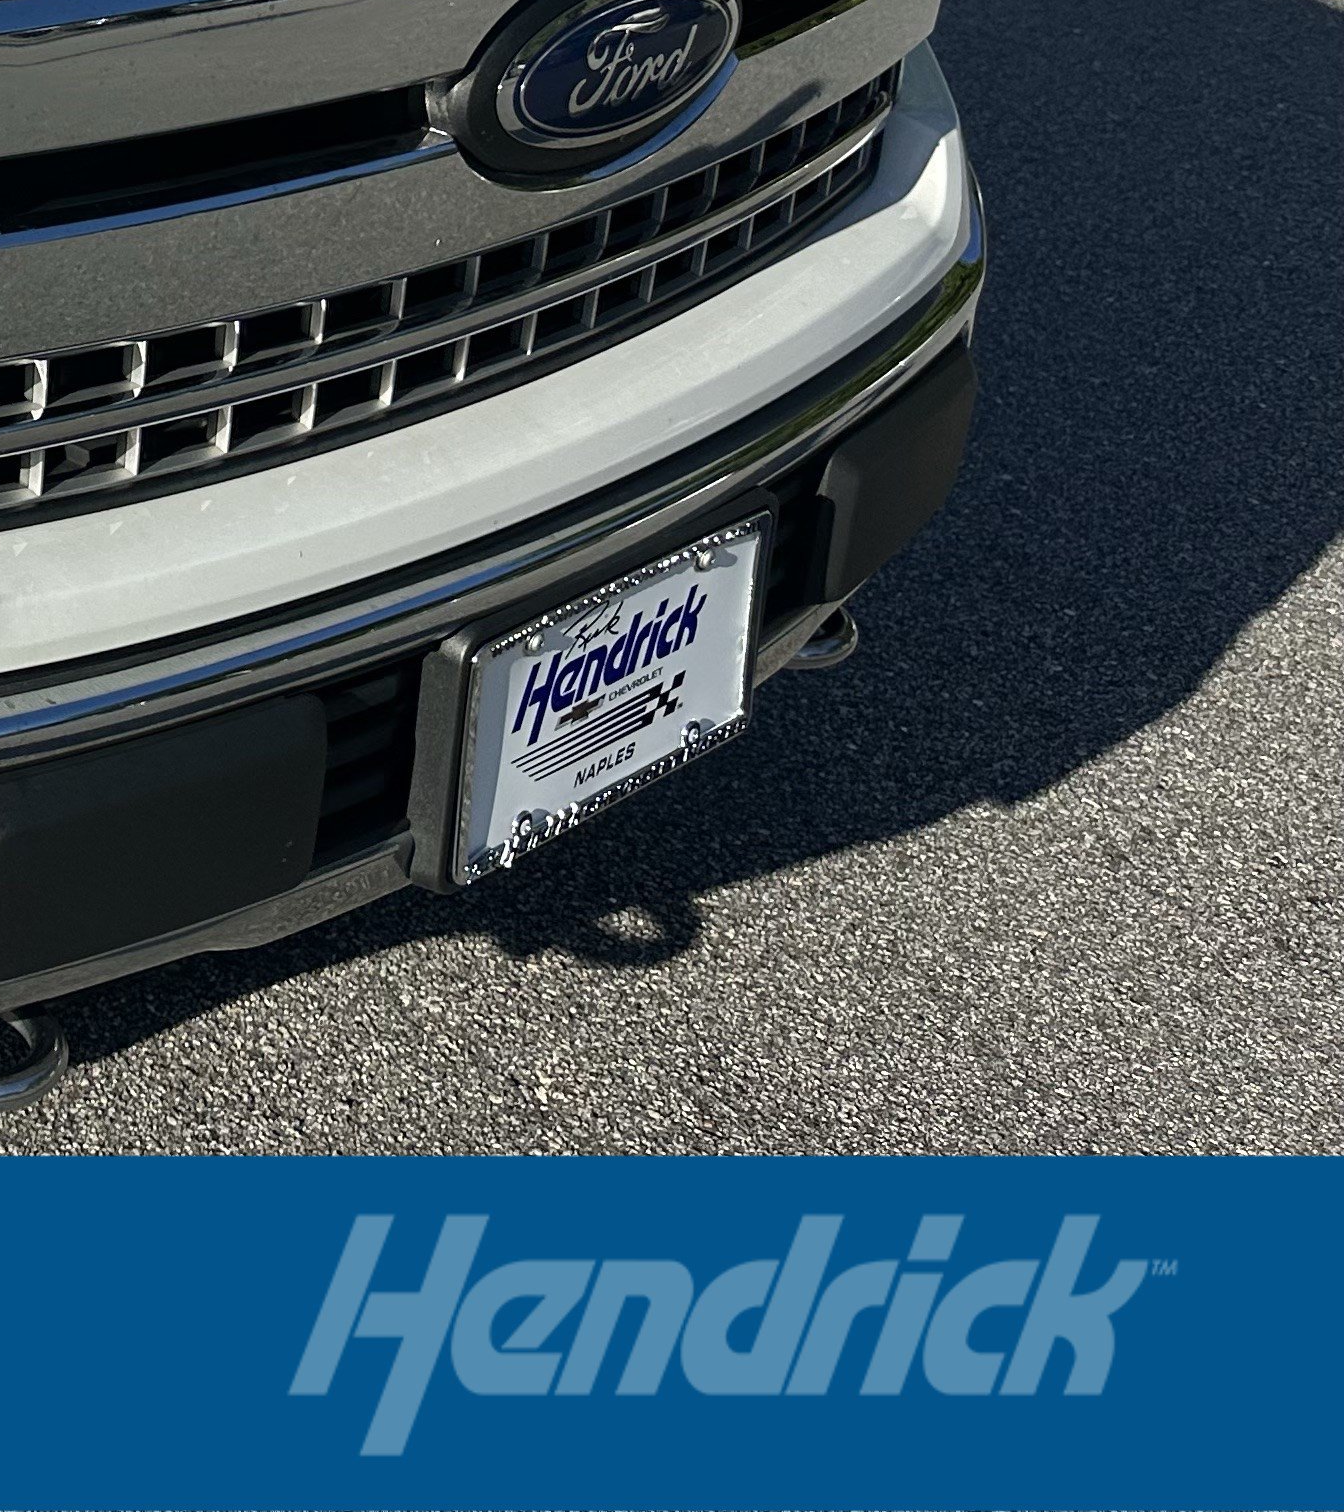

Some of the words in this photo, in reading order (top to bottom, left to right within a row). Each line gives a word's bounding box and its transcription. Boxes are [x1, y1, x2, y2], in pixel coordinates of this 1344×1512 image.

[568, 6, 698, 118] Ford
[511, 583, 709, 748] Hendrick
[608, 666, 664, 702] CHEVROLET
[573, 741, 637, 789] NAPLES
